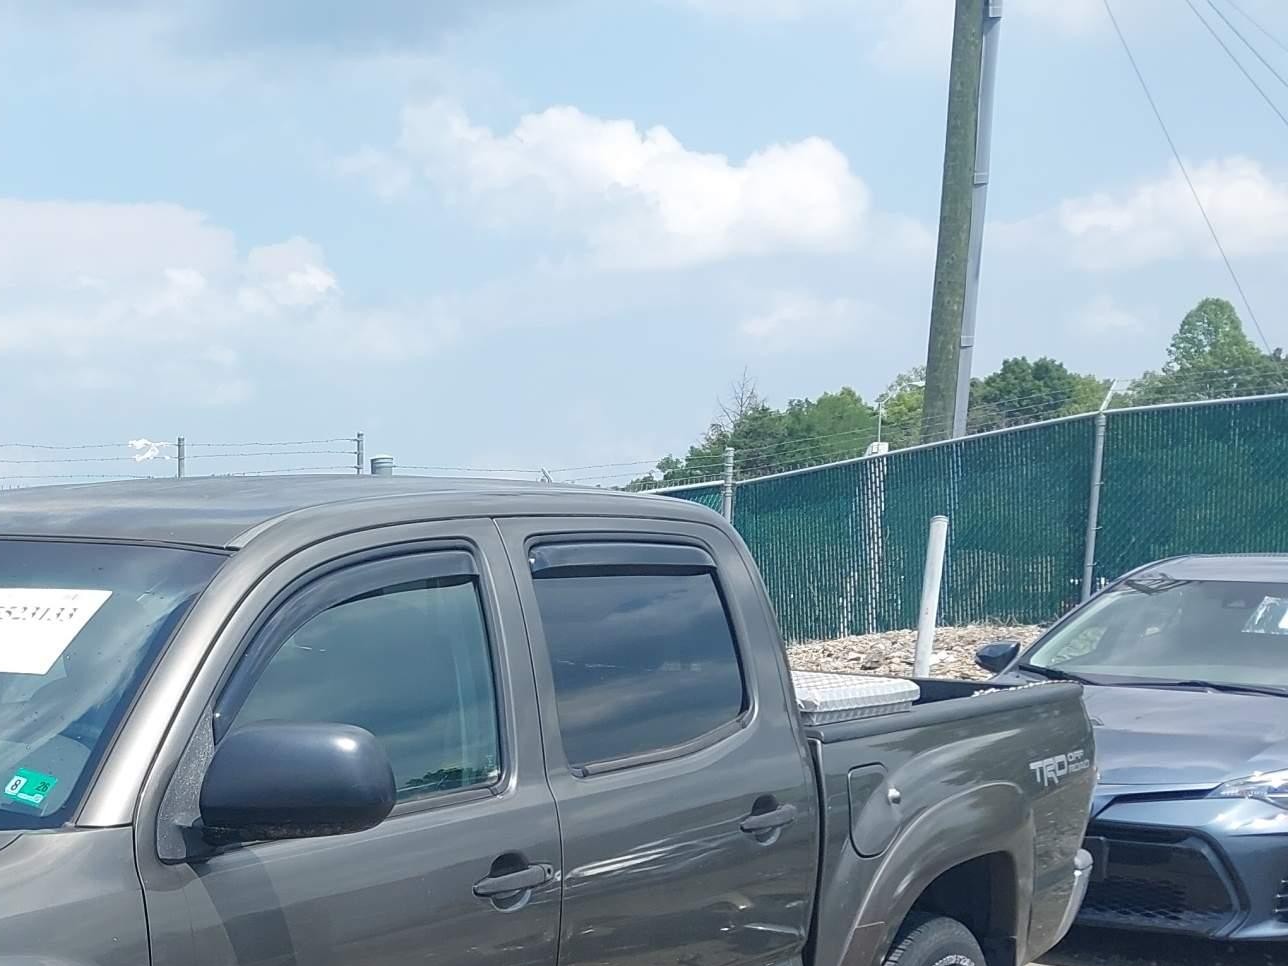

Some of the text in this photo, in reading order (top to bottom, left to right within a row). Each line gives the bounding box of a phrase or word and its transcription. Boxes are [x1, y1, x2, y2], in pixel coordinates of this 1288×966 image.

[1029, 754, 1067, 787] TRD
[10, 779, 21, 791] 8
[36, 781, 50, 793] 26
